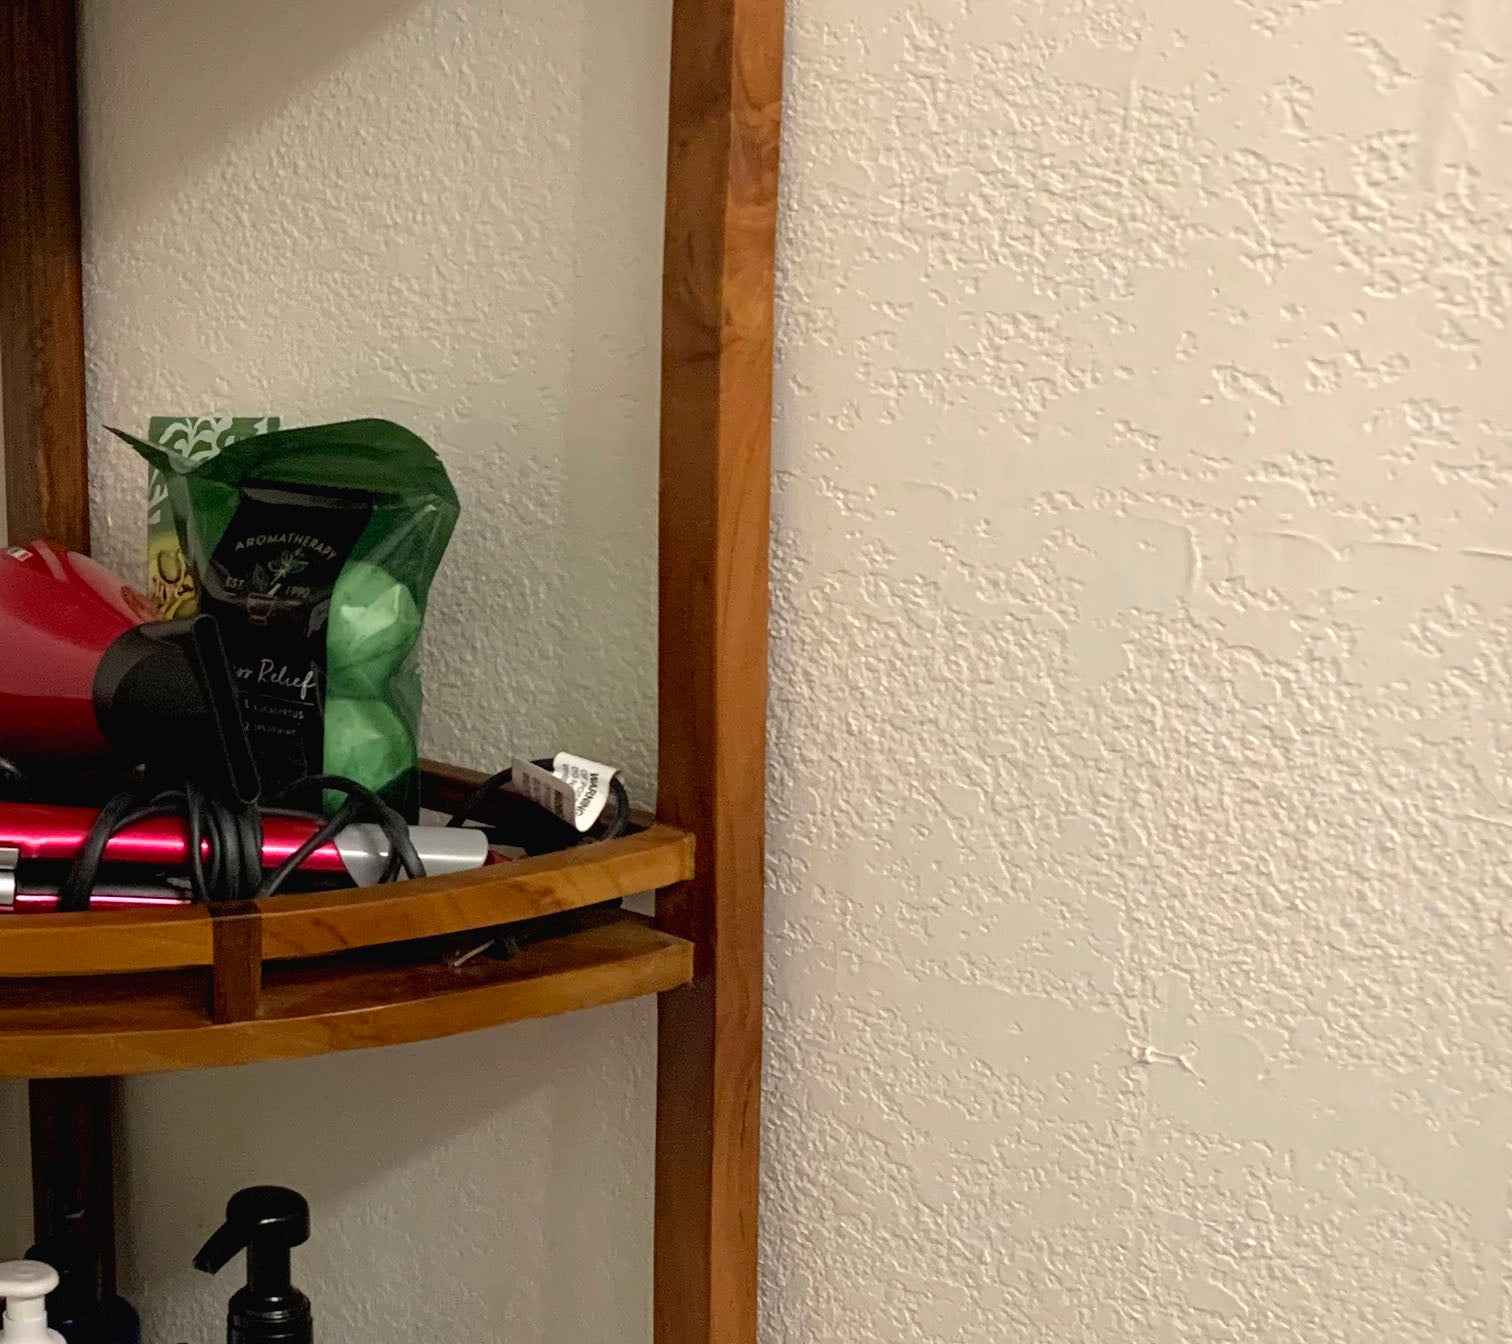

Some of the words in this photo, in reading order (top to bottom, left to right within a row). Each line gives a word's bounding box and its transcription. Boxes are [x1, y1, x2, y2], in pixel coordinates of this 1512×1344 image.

[234, 532, 337, 561] AROMATHERAPY
[257, 658, 316, 701] Relief
[574, 772, 600, 817] WARNING
